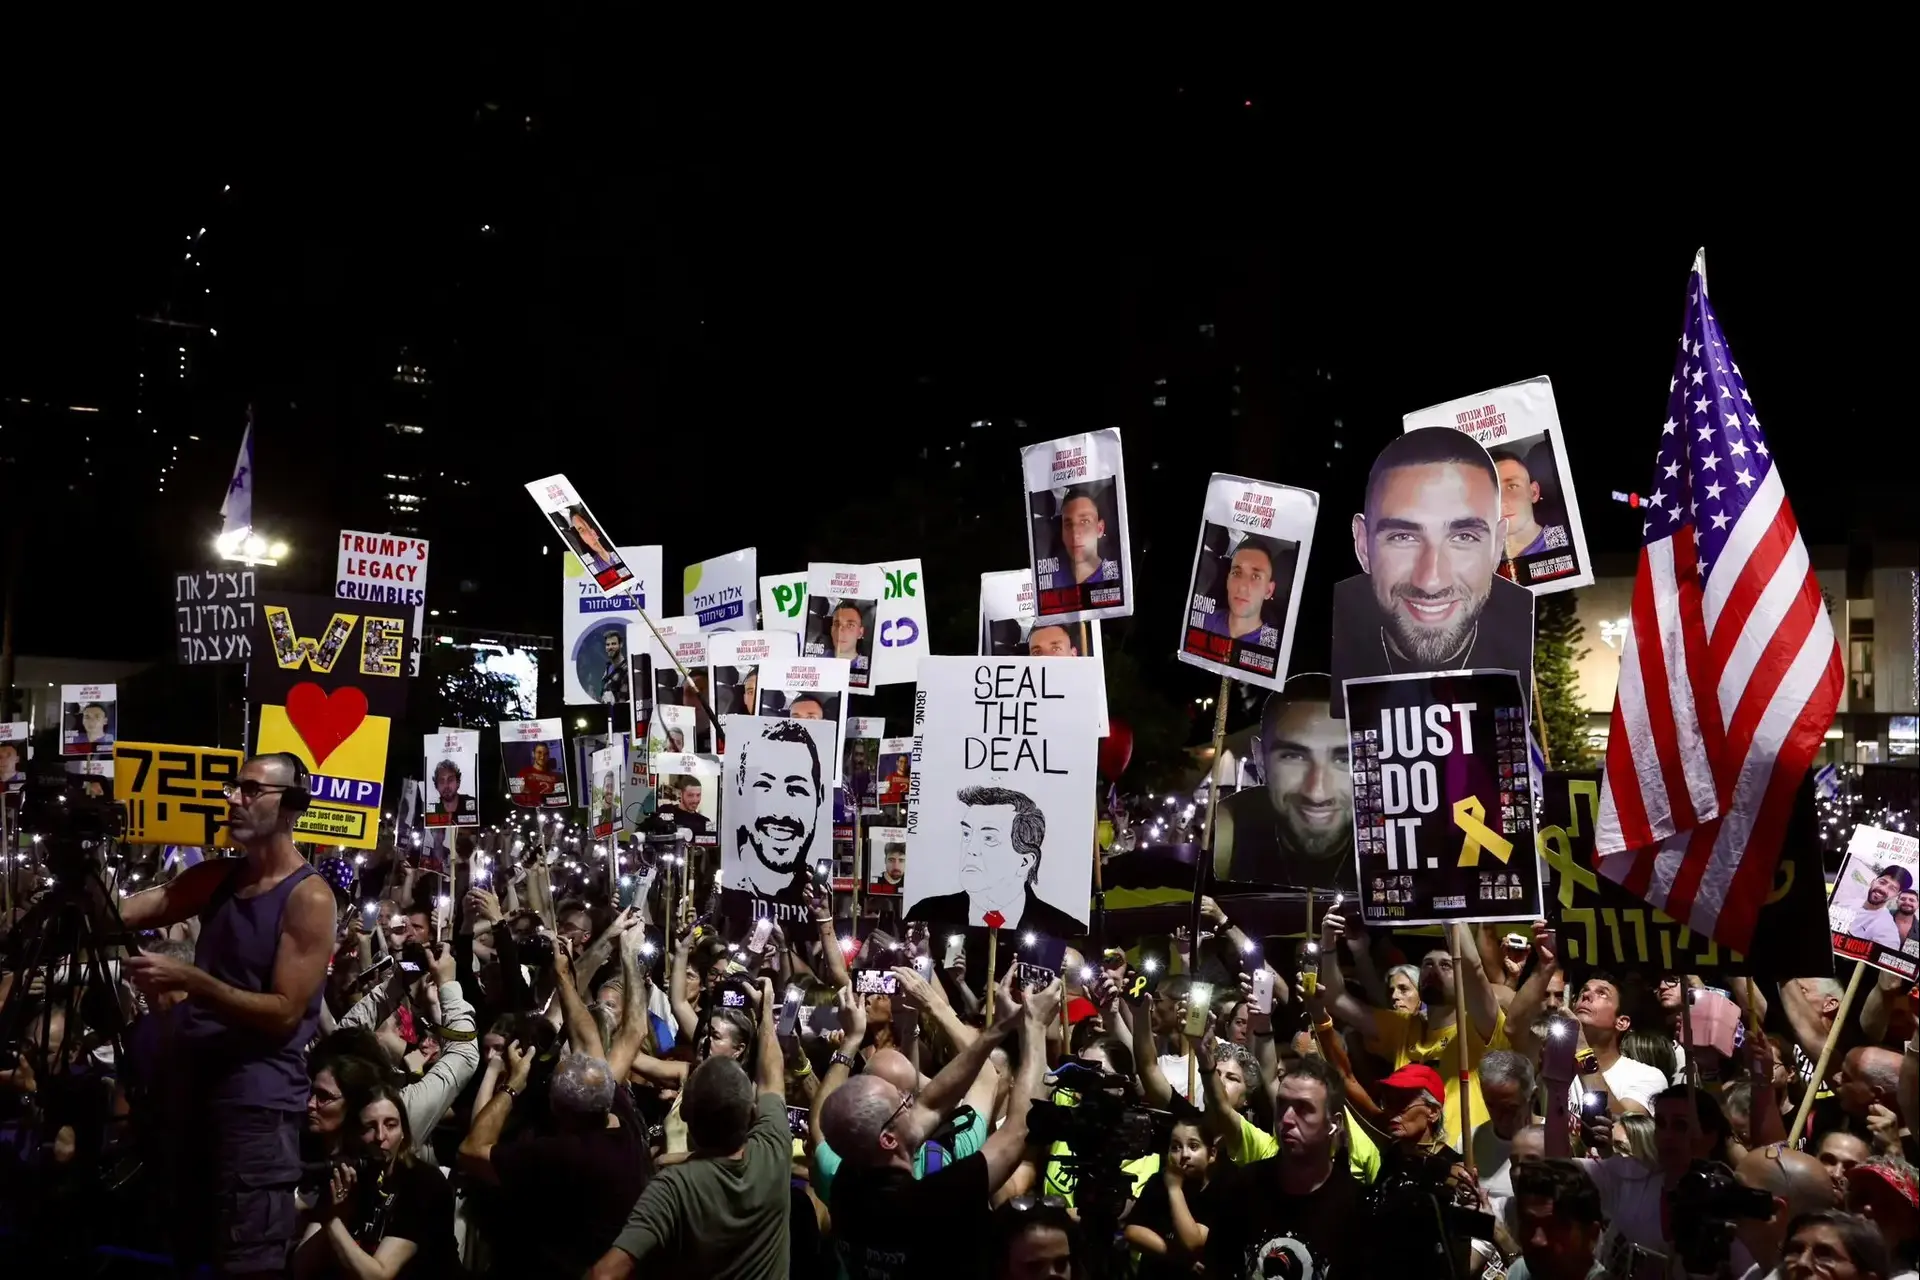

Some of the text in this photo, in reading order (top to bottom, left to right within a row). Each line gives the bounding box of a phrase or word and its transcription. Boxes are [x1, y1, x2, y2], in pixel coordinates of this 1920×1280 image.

[1476, 412, 1506, 430] ANGREST
[1052, 456, 1087, 471] MATAN ANGREST
[1234, 501, 1276, 518] MATAN ANGREST
[342, 533, 426, 560] TRUMP'S
[346, 558, 418, 582] LEGACY
[1037, 557, 1060, 574] BRING
[1530, 560, 1574, 578] FAMILIES FORUM
[176, 570, 255, 602] תציל את
[336, 579, 424, 607] CRUMBLES
[1038, 574, 1053, 590] HIM
[585, 598, 622, 610] שיחזור
[694, 585, 742, 609] אלון אהל
[1192, 593, 1216, 614] BRING
[178, 602, 255, 634] המדינה
[700, 604, 739, 623] עד שיחזור
[1190, 611, 1205, 629] HIM
[263, 605, 405, 677] WE
[805, 643, 825, 655] BRING
[974, 664, 1065, 700] SEAL
[974, 701, 1039, 736] THE
[1377, 702, 1478, 760] JUST
[907, 690, 927, 836] BRING THEM HOME NOW
[964, 737, 1069, 775] DEAL
[116, 747, 239, 800] 729
[309, 775, 373, 801] UMP
[1380, 760, 1439, 815] DO
[309, 821, 329, 832] entire
[329, 824, 348, 834] world
[317, 811, 331, 821] just
[331, 813, 344, 822] one
[345, 814, 356, 823] life
[1384, 817, 1439, 870] IT.
[751, 898, 809, 924] איתי חן
[1845, 934, 1874, 956] NOW!
